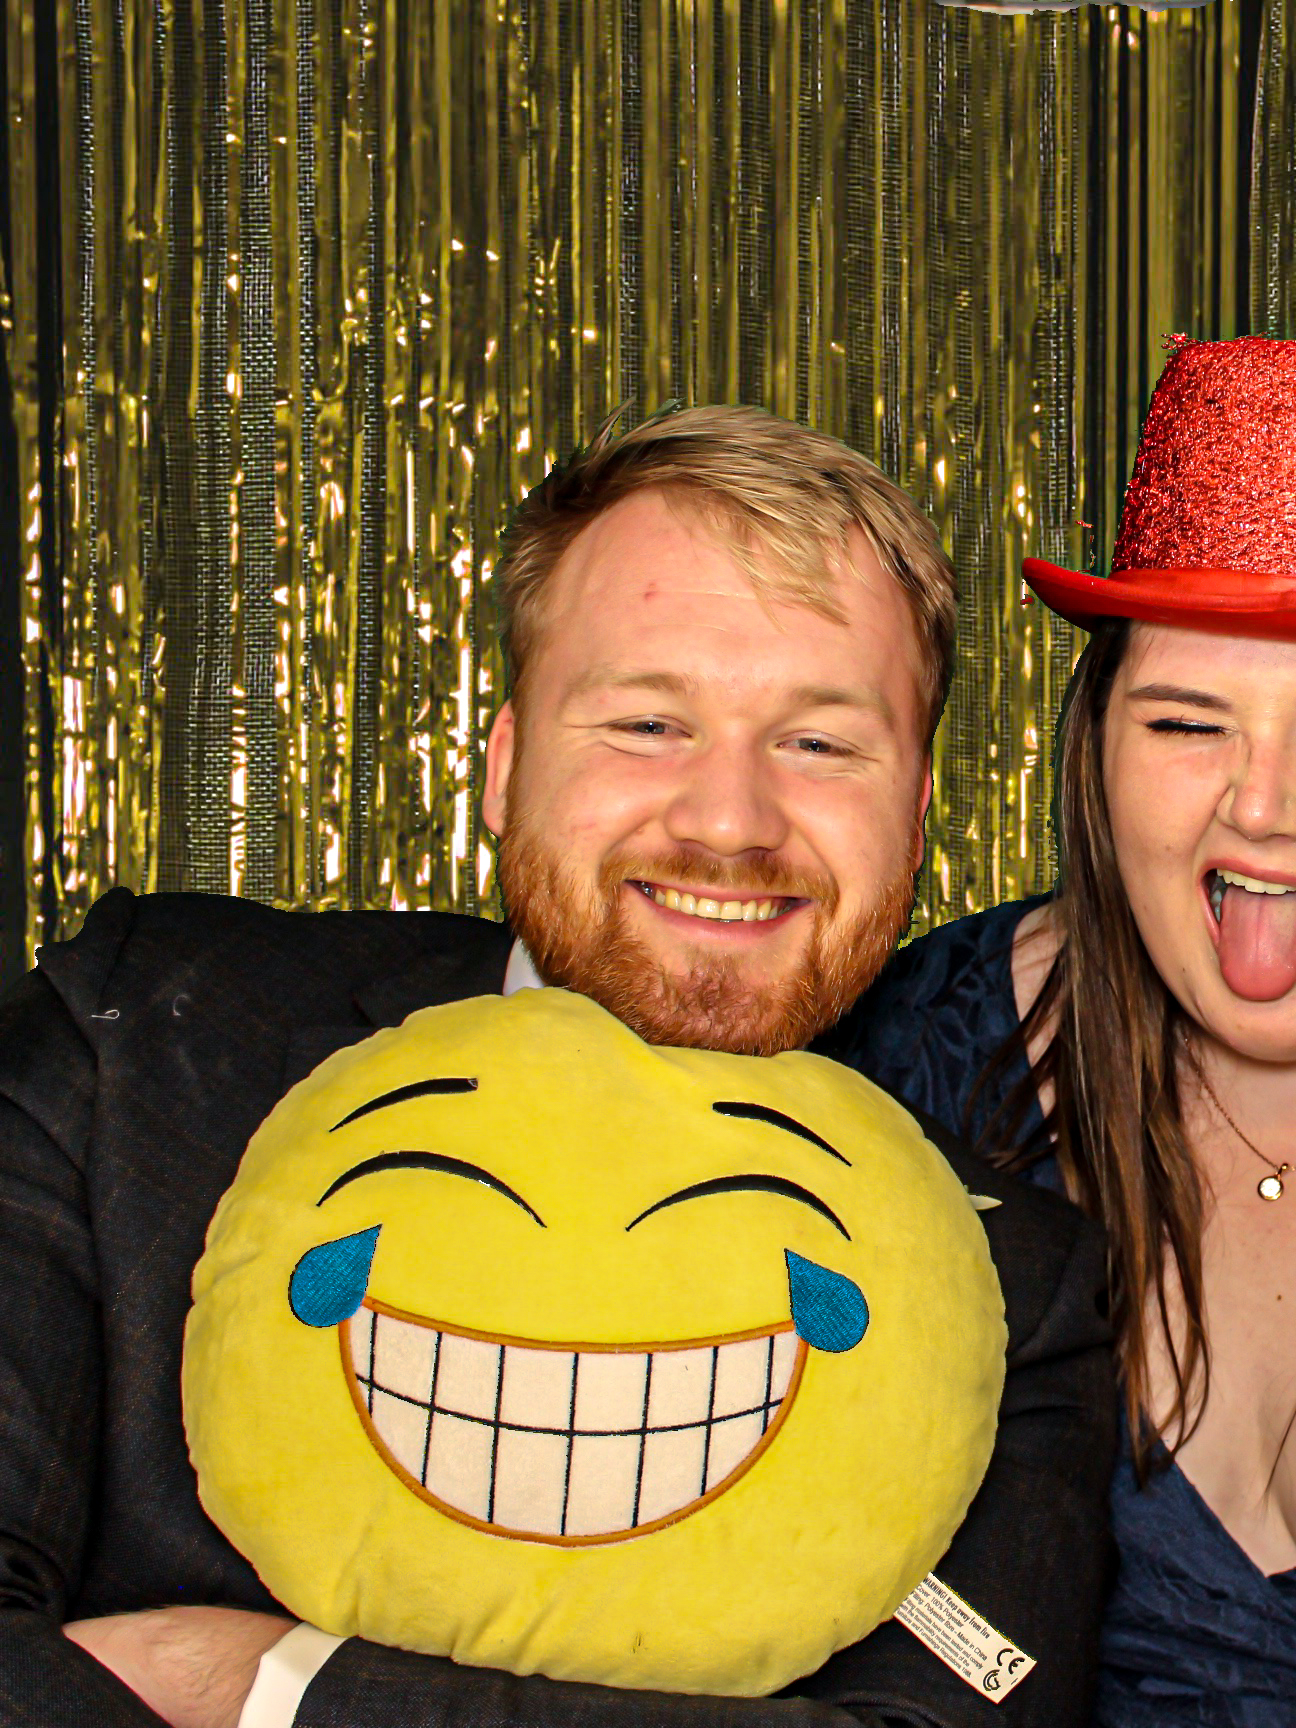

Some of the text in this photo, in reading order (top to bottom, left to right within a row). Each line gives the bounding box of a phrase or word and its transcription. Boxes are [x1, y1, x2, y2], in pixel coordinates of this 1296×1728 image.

[922, 1576, 990, 1639] WARNING! Keep away from fire
[924, 1603, 945, 1622] Polyester
[957, 1632, 970, 1645] Made
[974, 1647, 987, 1661] China
[931, 1597, 944, 1610] 100%
[943, 1608, 964, 1627] Polyester
